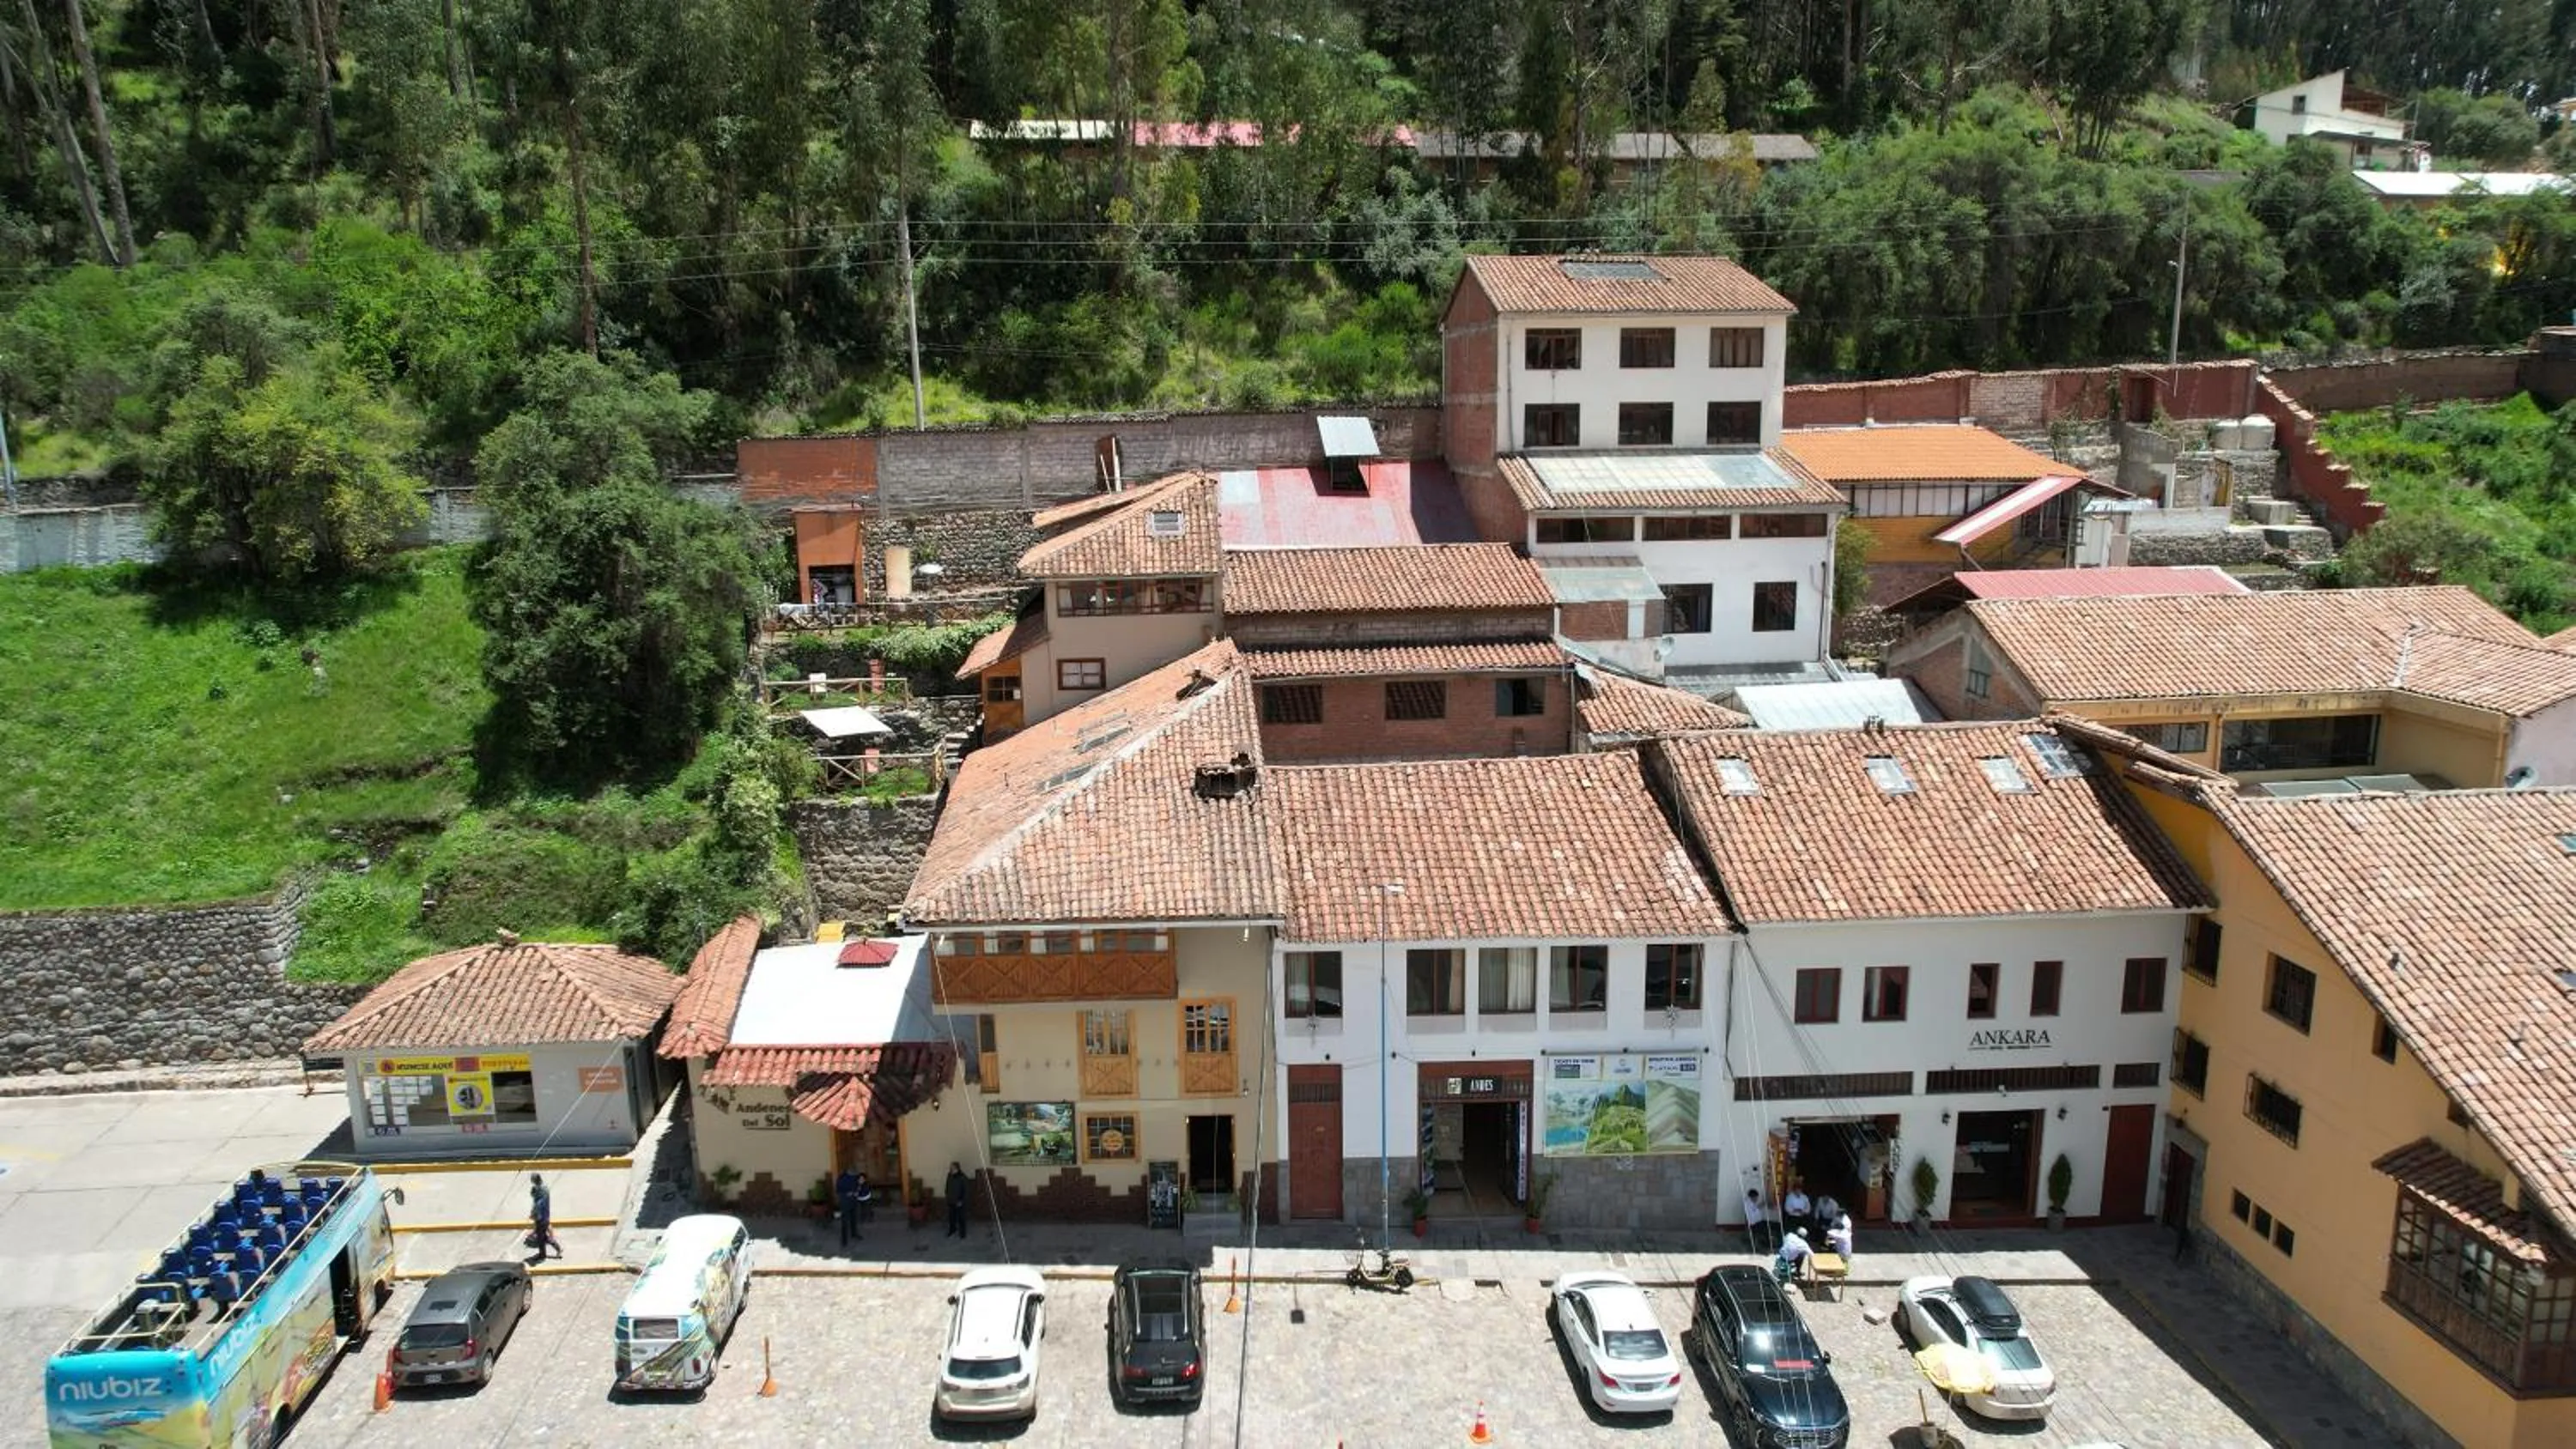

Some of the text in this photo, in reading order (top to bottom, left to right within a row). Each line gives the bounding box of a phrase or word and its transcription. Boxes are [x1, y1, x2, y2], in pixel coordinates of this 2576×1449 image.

[1969, 1029, 2050, 1046] ANKARA
[736, 1102, 791, 1113] Andenes
[764, 1113, 790, 1126] Sol
[58, 1376, 162, 1401] niubiz
